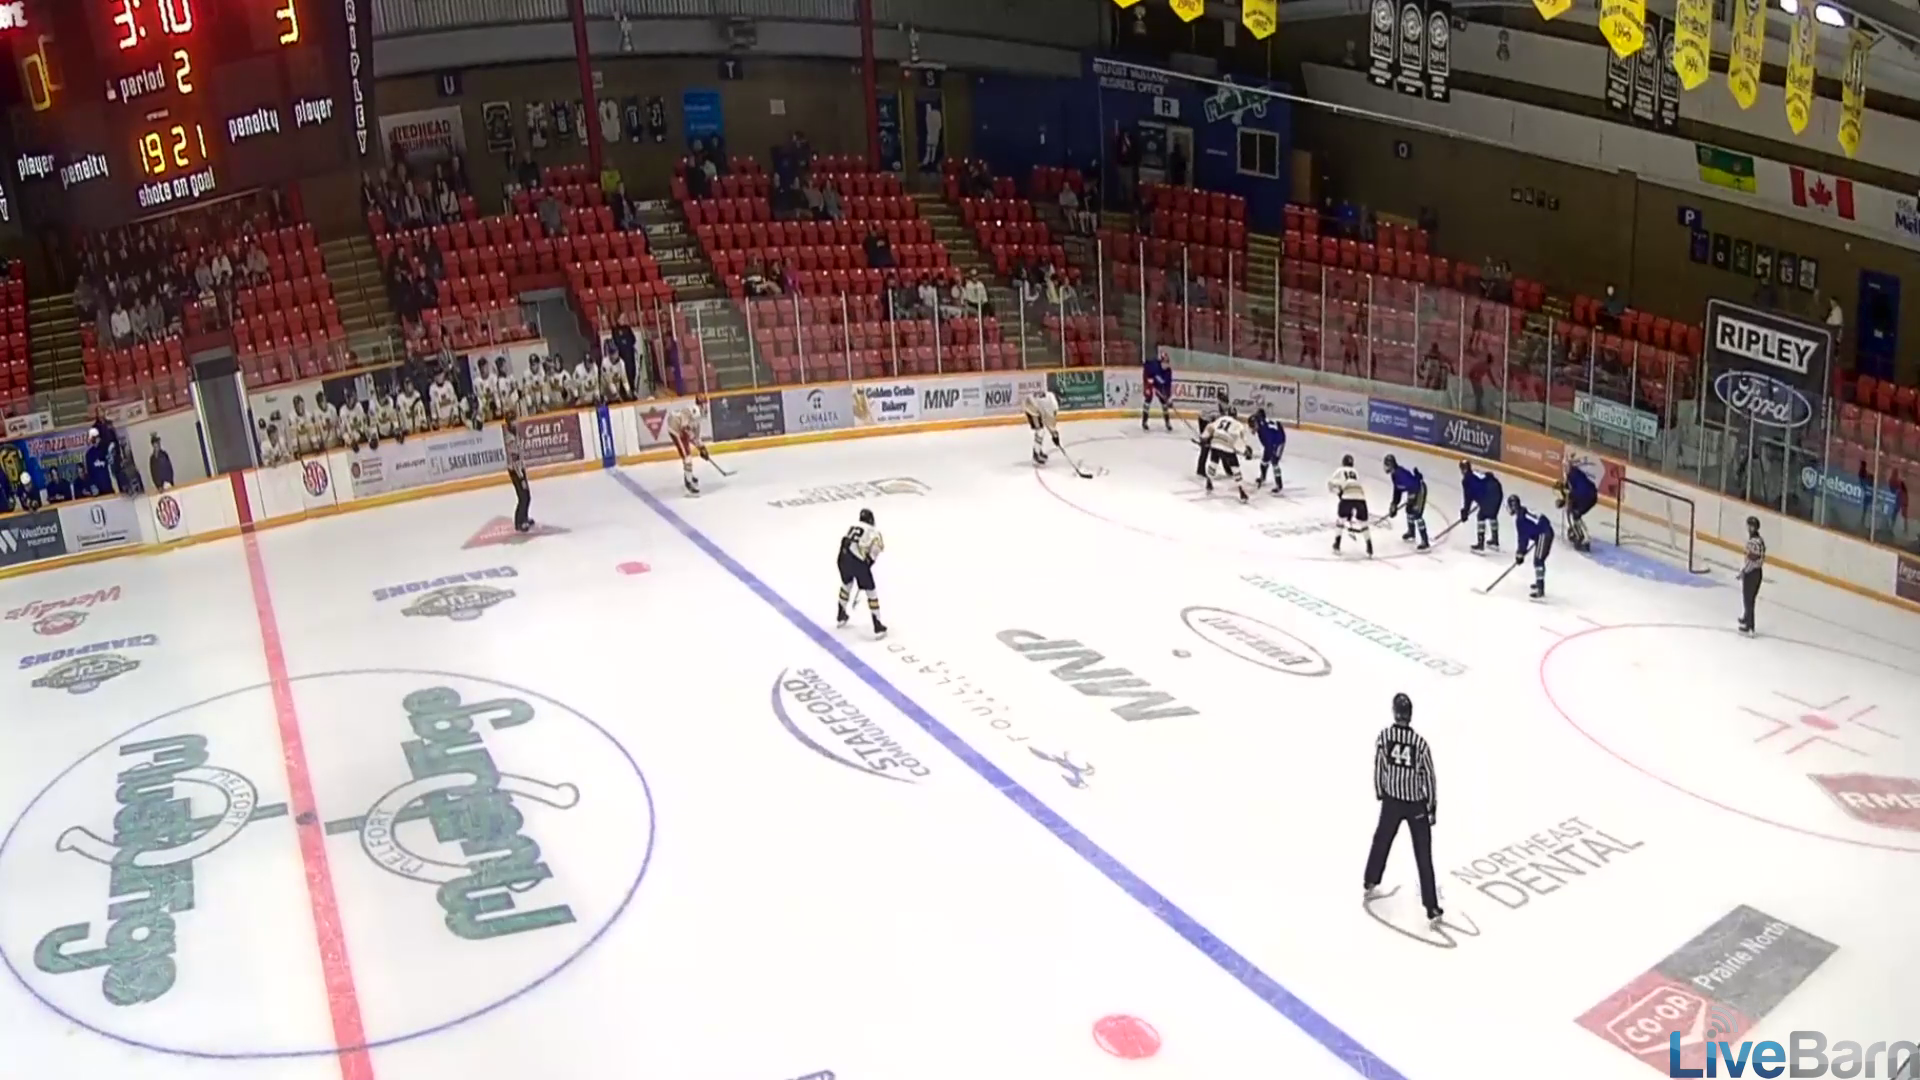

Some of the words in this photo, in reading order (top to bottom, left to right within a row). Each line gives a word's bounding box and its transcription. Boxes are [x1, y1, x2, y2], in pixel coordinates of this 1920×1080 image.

[119, 63, 165, 104] period
[174, 49, 193, 95] 2
[227, 108, 280, 145] penalty
[294, 98, 334, 129] player
[1161, 100, 1172, 115] R
[16, 153, 56, 182] player
[60, 154, 109, 191] penalty
[174, 178, 190, 197] on
[190, 166, 217, 192] goal
[1684, 209, 1696, 226] P
[1718, 319, 1814, 370] RIPLEY
[924, 388, 960, 410] MNP
[985, 389, 1012, 406] NOW
[1731, 376, 1791, 423] Ford
[1443, 419, 1495, 451] Affinity
[20, 523, 58, 539] Westland
[371, 565, 519, 602] CHAMPIONS
[18, 633, 158, 671] CHAMPIONS
[886, 643, 1030, 744] FOUILLARD
[996, 629, 1200, 722] MNP
[782, 679, 899, 772] STAFFORD
[796, 667, 931, 778] COMMUNICATIONS
[1390, 742, 1412, 767] 44
[210, 771, 251, 829] MELFORT
[368, 808, 423, 876] MELFORT
[1450, 816, 1593, 885] NORTHEAST
[1476, 829, 1645, 910] DENTAL
[1693, 949, 1753, 992] Prairie
[1740, 919, 1789, 961] North
[1623, 993, 1692, 1044] CO-OP
